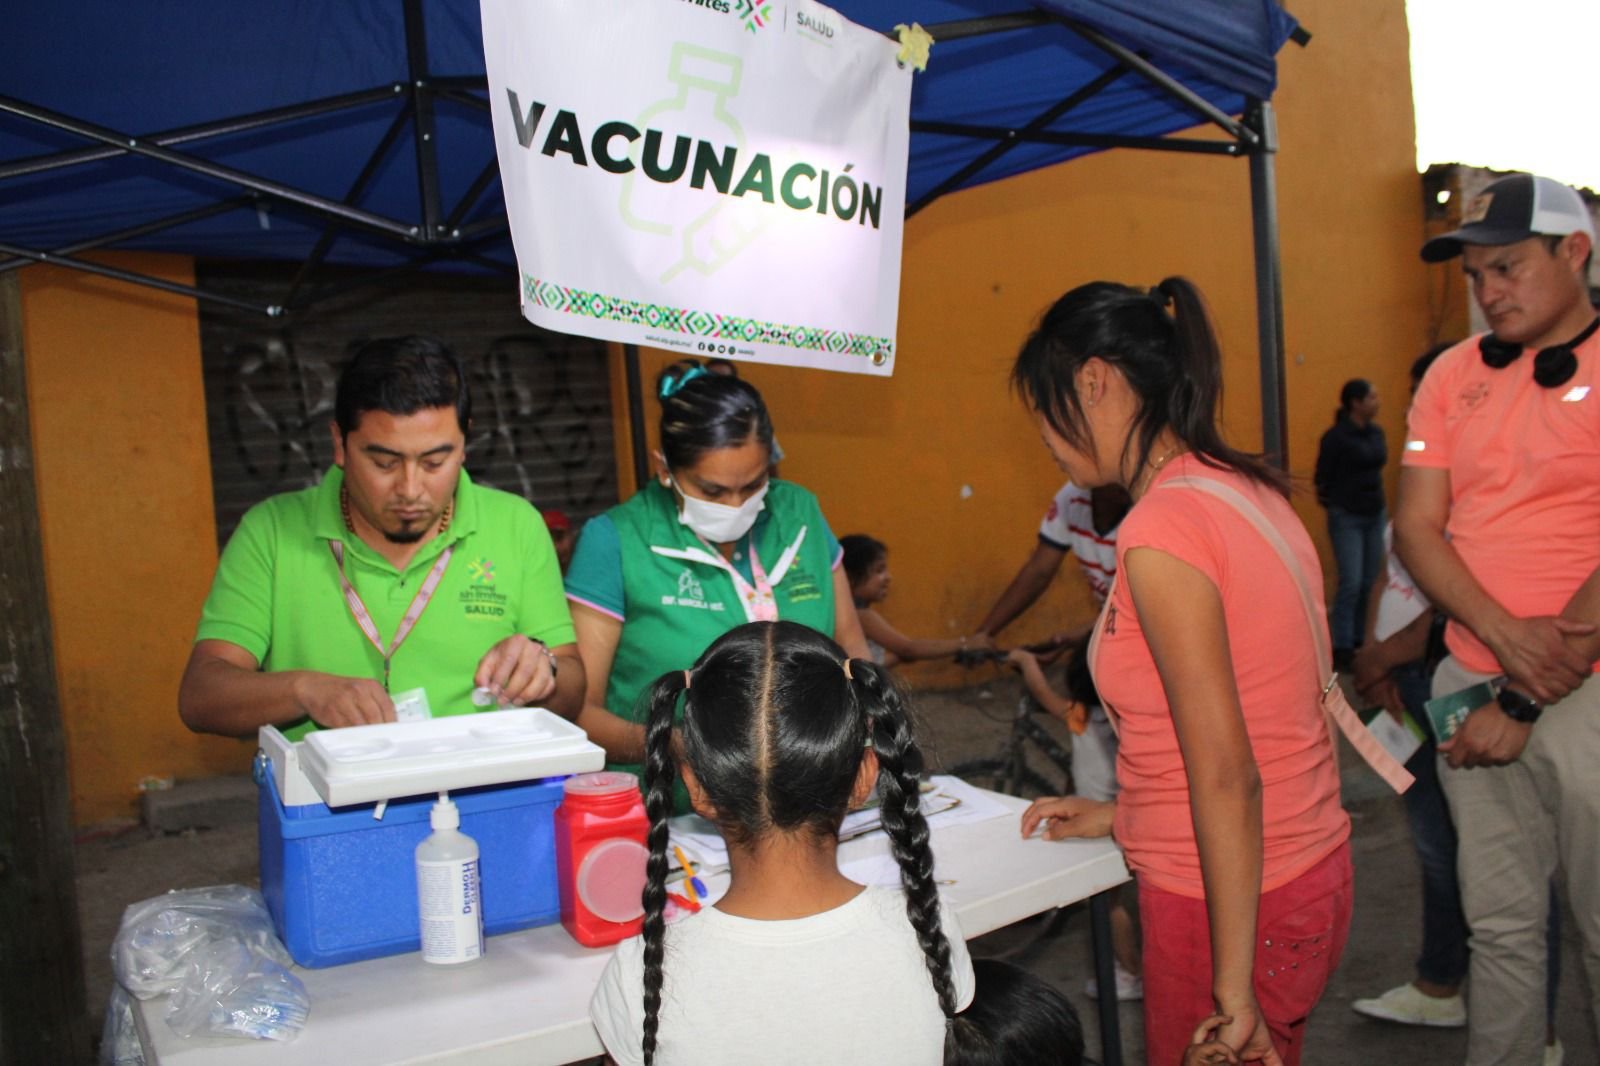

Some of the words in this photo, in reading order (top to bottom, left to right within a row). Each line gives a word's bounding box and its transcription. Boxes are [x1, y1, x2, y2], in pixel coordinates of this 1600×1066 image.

[796, 12, 835, 39] SALUD
[506, 87, 883, 230] VACUNACIÓN
[465, 605, 505, 616] SALUD
